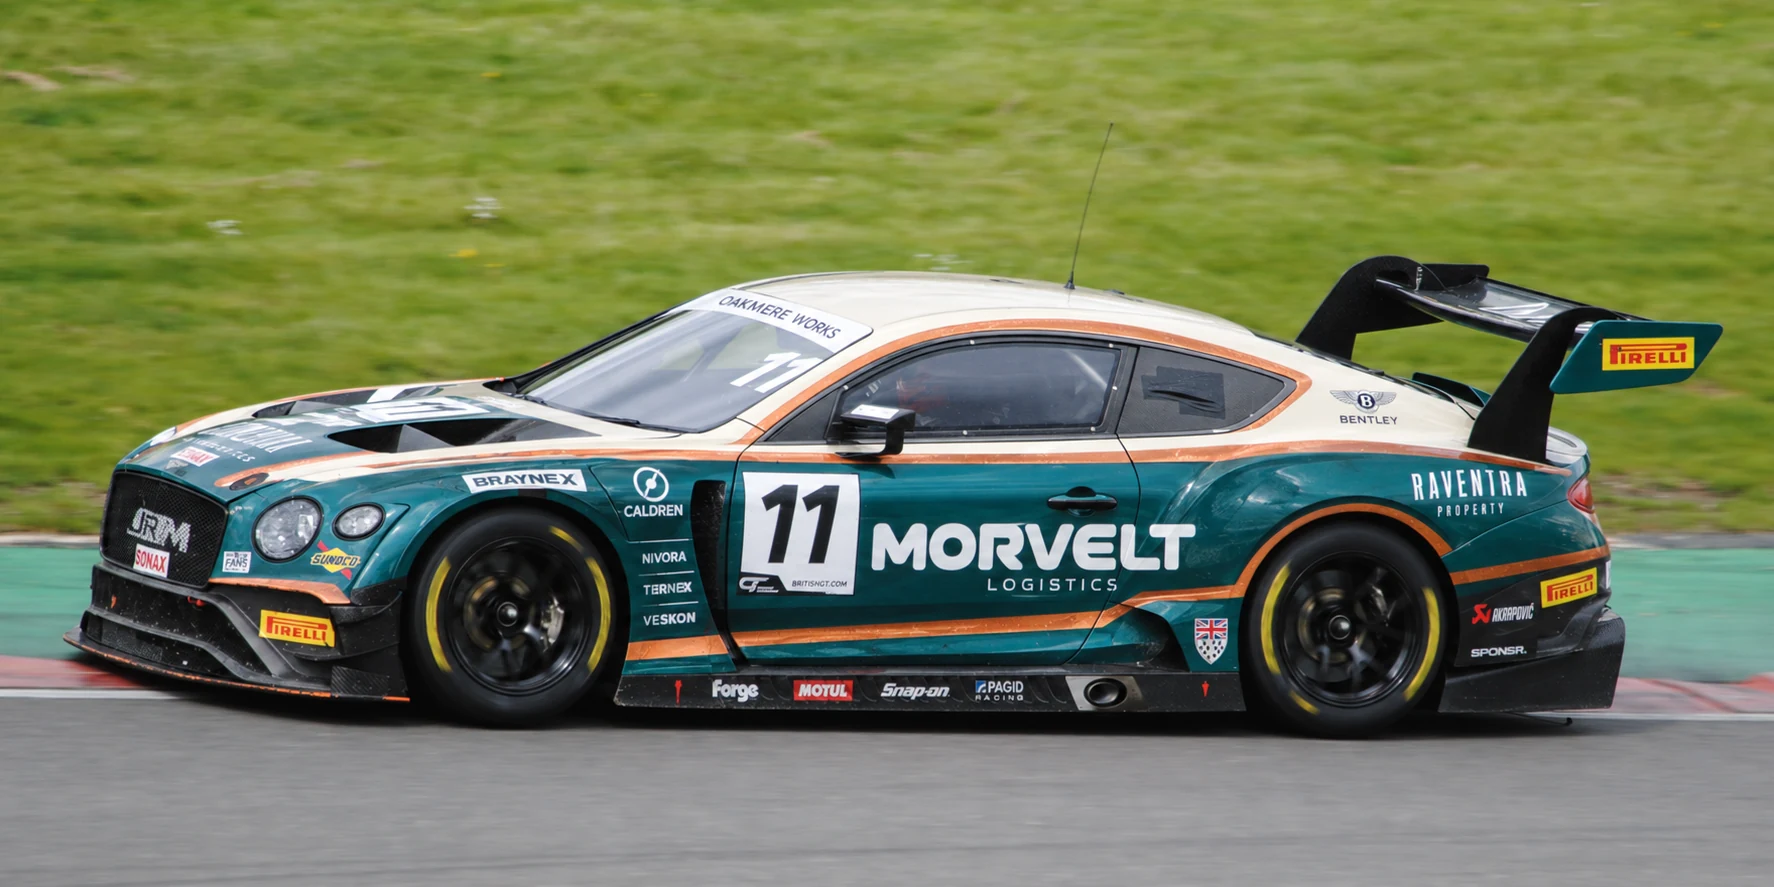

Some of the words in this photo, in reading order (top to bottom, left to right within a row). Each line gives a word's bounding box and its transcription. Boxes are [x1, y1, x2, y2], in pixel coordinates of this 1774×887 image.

[718, 295, 793, 320] OAKMERE
[791, 312, 841, 339] WORKS
[1609, 343, 1687, 365] PIRELLI
[729, 352, 824, 394] 11
[1339, 415, 1398, 425] BENTLEY
[472, 473, 579, 487] BRAYNEX
[1411, 469, 1528, 501] RAVENTRA
[623, 504, 684, 518] CALDREN
[1437, 502, 1504, 517] PROPERTY
[761, 484, 840, 564] 11
[871, 523, 1196, 571] MORVELT
[135, 549, 167, 573] SONAX
[225, 558, 248, 568] FANS
[312, 554, 358, 567] SUNOCO
[642, 551, 687, 564] NIVORA
[643, 582, 692, 596] TERNEX
[987, 578, 1118, 591] LOGISTICS
[1547, 574, 1594, 602] PIRELLI
[643, 612, 696, 626] VESKON
[266, 616, 328, 641] PIRELLI
[1471, 646, 1527, 658] SPONSR.
[712, 679, 759, 703] Forge
[798, 684, 848, 697] MOTUL
[880, 683, 950, 700] Snap-on
[987, 681, 1024, 693] PAGID
